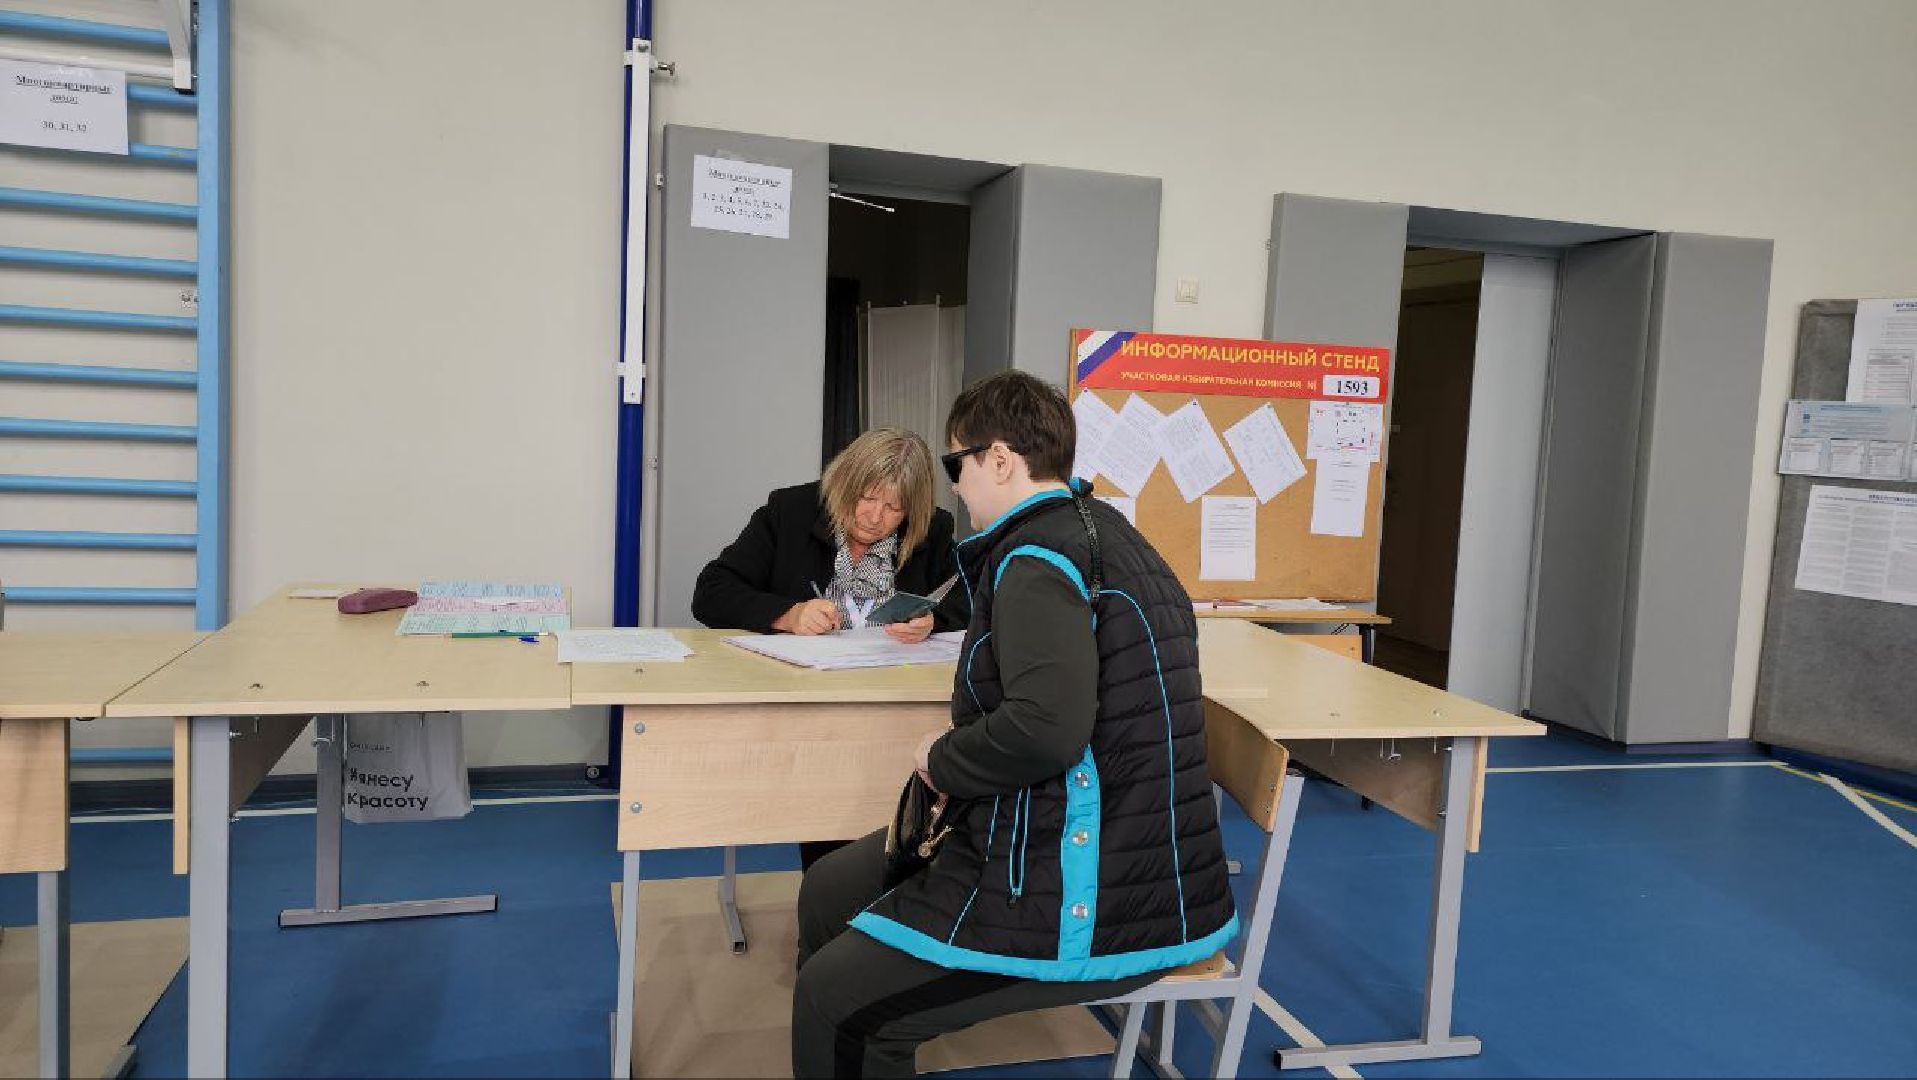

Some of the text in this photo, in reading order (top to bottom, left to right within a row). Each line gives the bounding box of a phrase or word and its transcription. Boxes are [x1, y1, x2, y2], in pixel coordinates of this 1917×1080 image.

[1120, 341, 1380, 373] ИНФОРМАЦИОННЫЙ СТЕНД
[1120, 371, 1180, 382] УЧАСТКОВАЯ
[1181, 374, 1254, 386] ИЗБИРАТЕЛЬНАЯ
[1337, 381, 1369, 395] 1593
